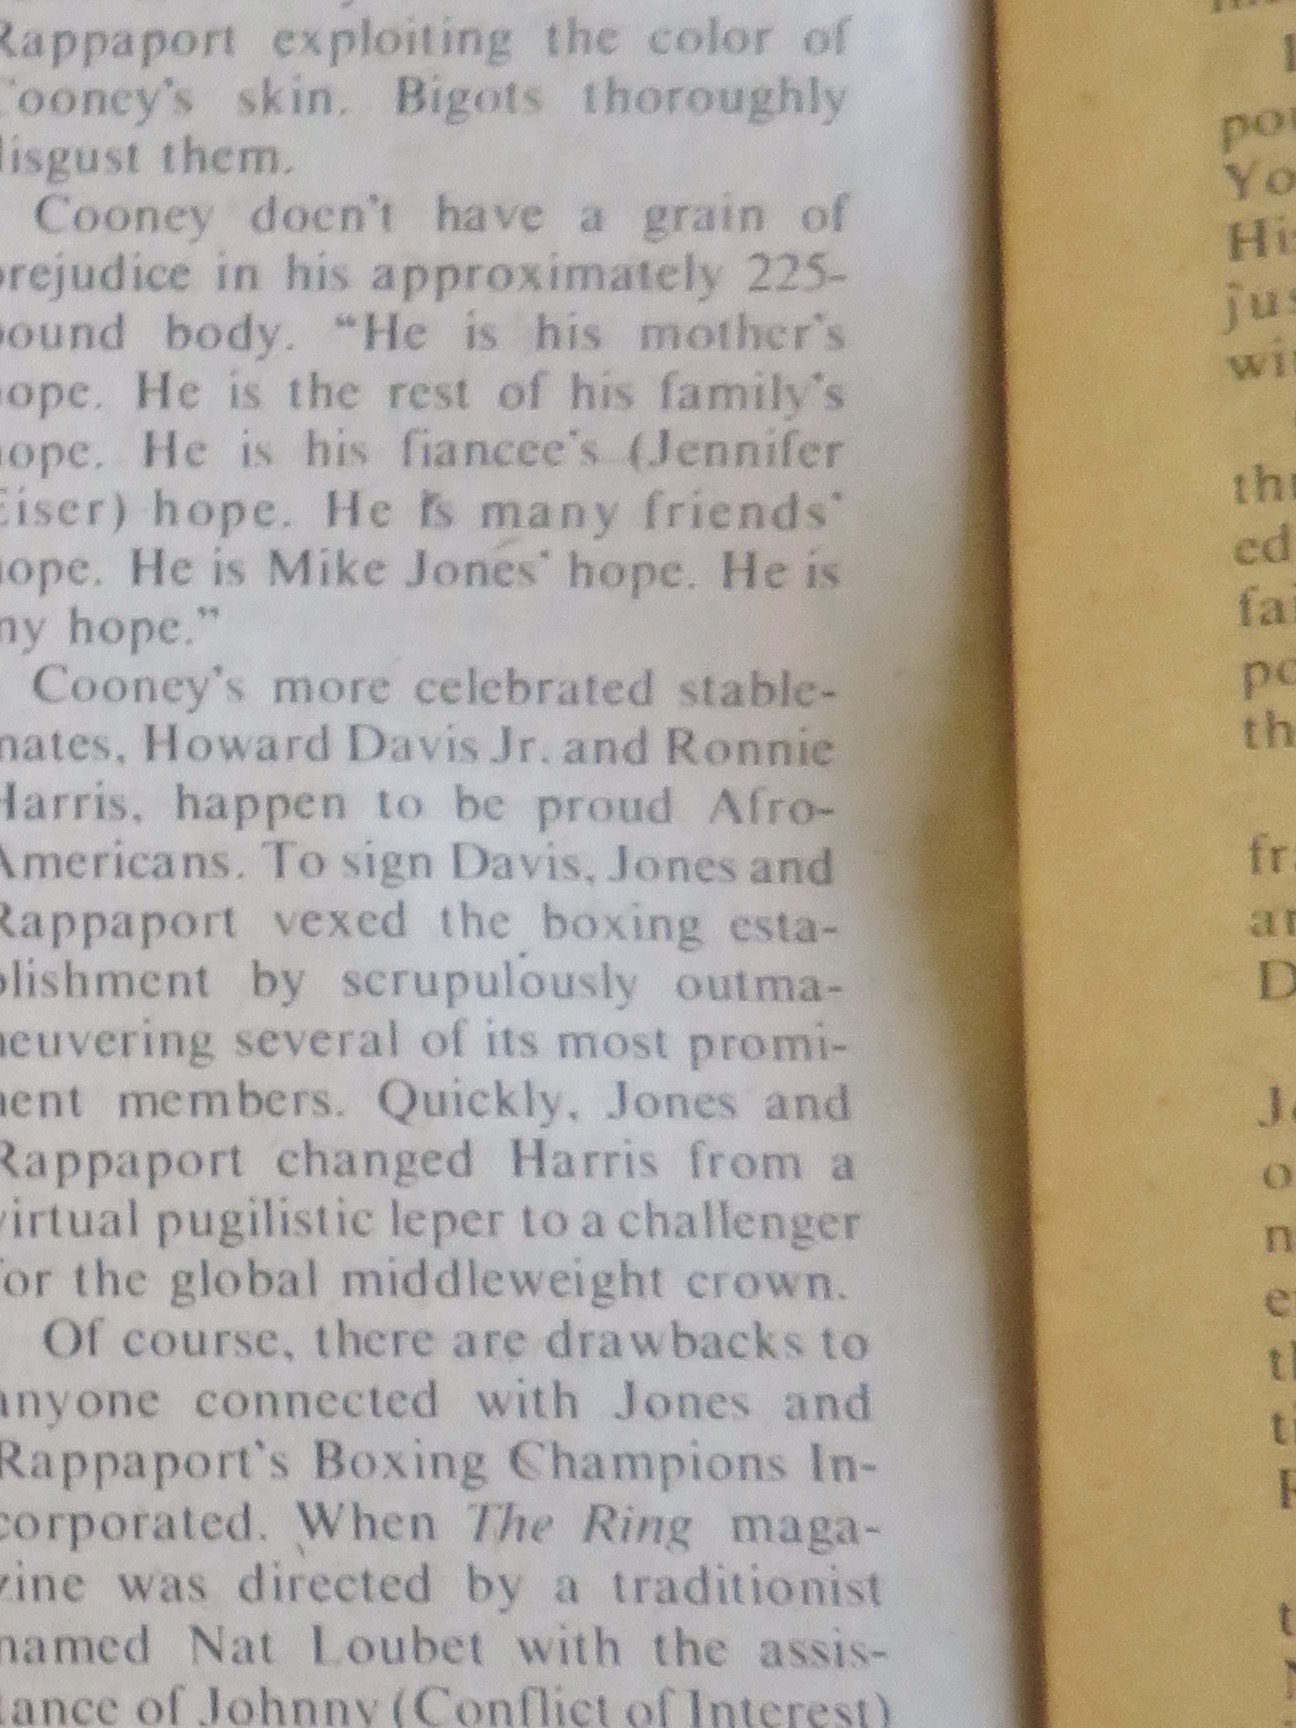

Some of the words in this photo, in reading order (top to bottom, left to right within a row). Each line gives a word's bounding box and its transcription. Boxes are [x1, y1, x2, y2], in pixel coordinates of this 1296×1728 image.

[31, 190, 216, 247] Cooney
[434, 190, 547, 236] have
[577, 203, 608, 235] a
[640, 201, 768, 252] grain
[798, 189, 854, 236] of
[140, 426, 210, 472] He
[239, 426, 276, 471] is
[303, 425, 371, 470] his
[399, 425, 602, 472] fiancee's
[624, 425, 847, 475] (Jennifer
[311, 1435, 490, 1495] Boxing
[506, 1437, 790, 1495] Champions
[808, 1440, 879, 1485] In-
